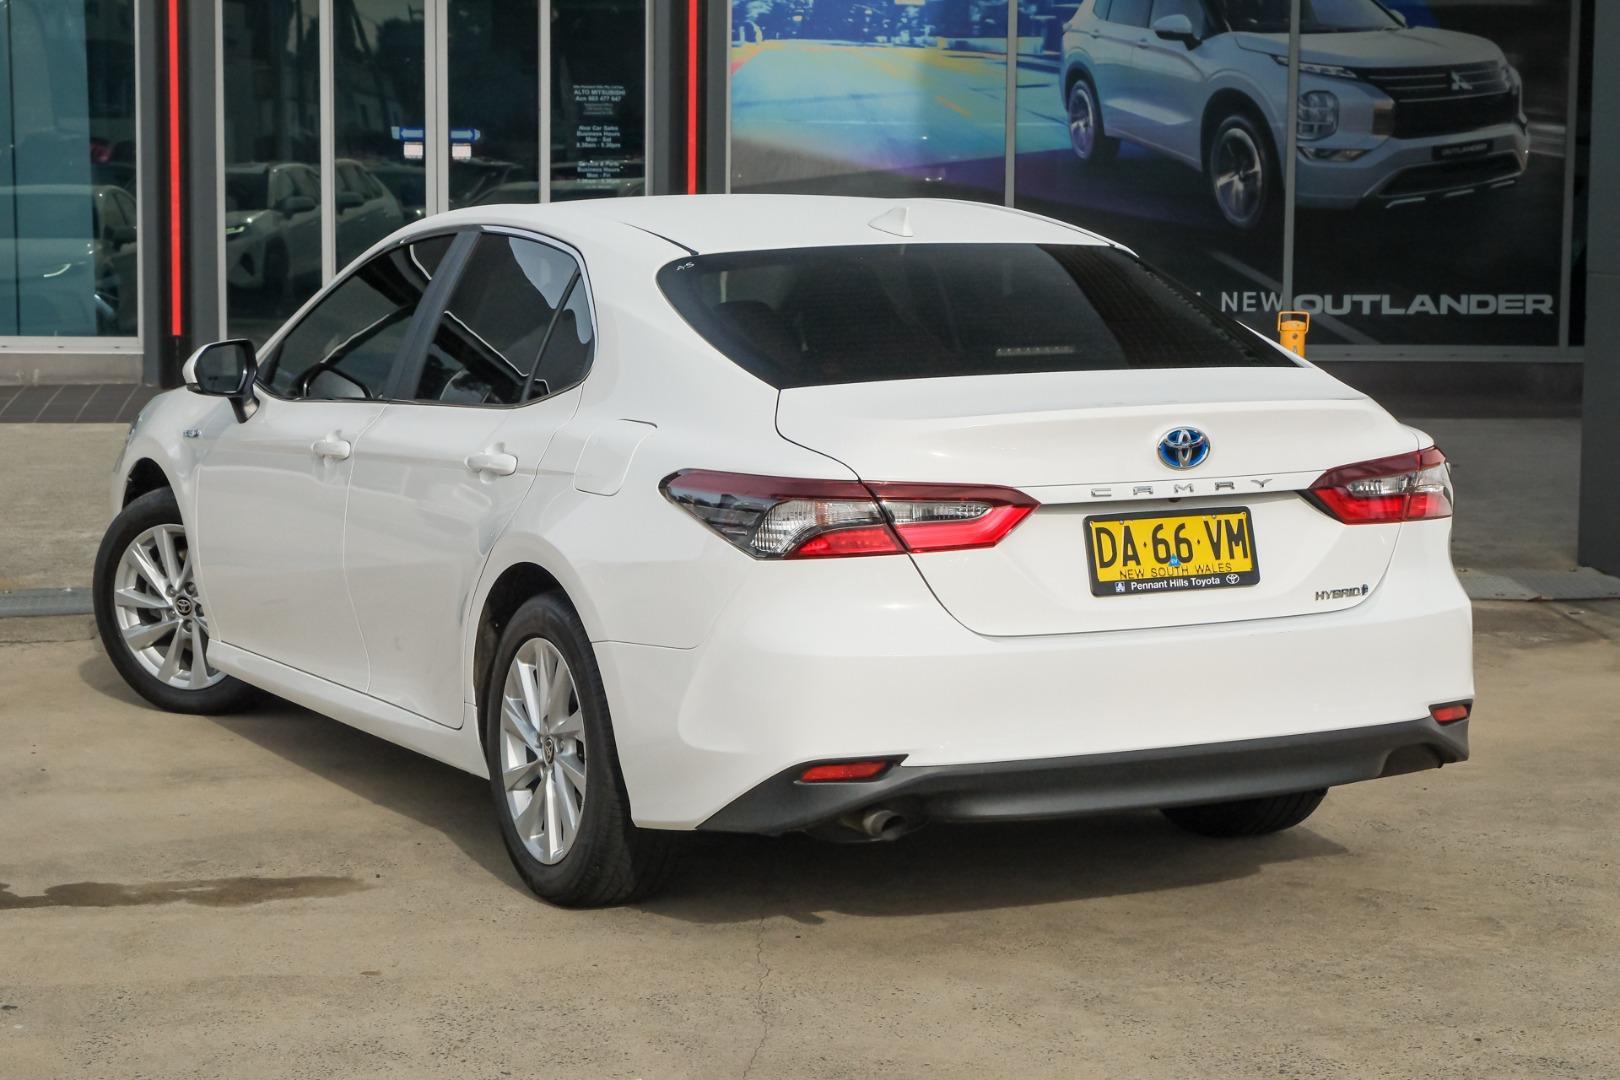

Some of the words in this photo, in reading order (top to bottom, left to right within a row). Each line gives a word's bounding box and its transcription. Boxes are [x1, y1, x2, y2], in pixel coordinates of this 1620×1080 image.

[1221, 291, 1283, 312] NEW
[1293, 294, 1554, 315] OUTLANDER
[1091, 478, 1273, 498] CAMRY
[1119, 568, 1145, 580] NEW
[1151, 566, 1189, 577] SOUTH
[1195, 562, 1232, 574] WALES
[1131, 580, 1168, 591] Pennant
[1170, 579, 1189, 588] Hills
[1192, 577, 1221, 588] Toyota
[1315, 586, 1362, 601] HYBRID
